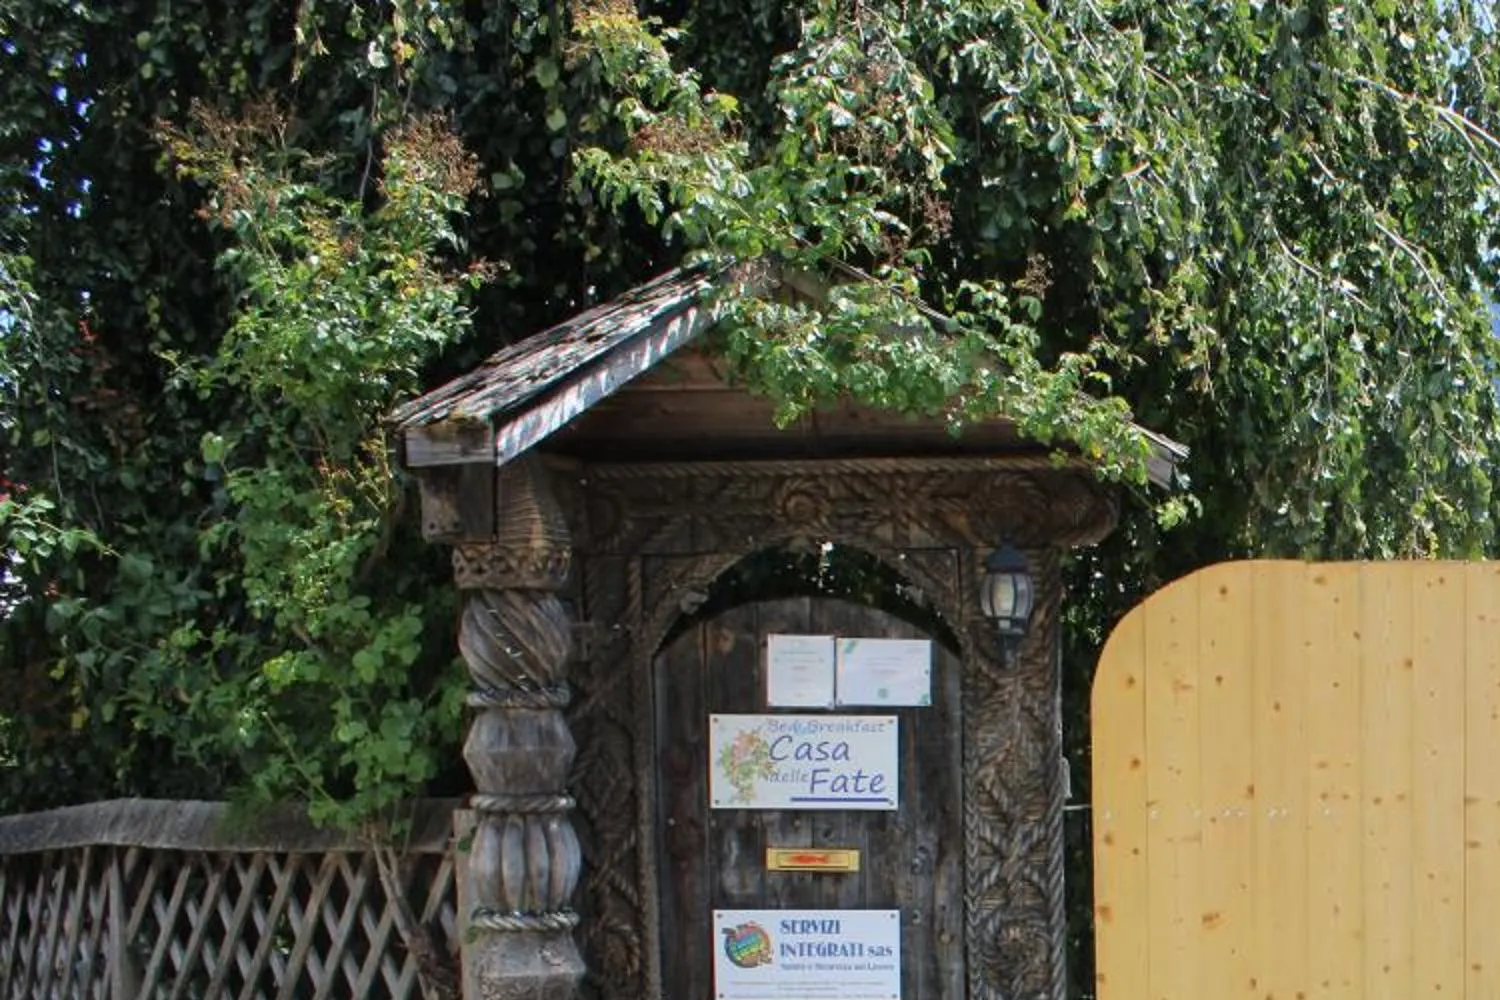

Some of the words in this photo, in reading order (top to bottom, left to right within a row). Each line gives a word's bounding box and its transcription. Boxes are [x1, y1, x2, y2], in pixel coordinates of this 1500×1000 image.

[769, 735, 850, 761] Casa
[769, 768, 809, 783] delle
[809, 768, 886, 794] Fate
[780, 919, 841, 935] SERVIZI
[780, 942, 863, 957] INTEGRATI
[867, 945, 893, 957] sas
